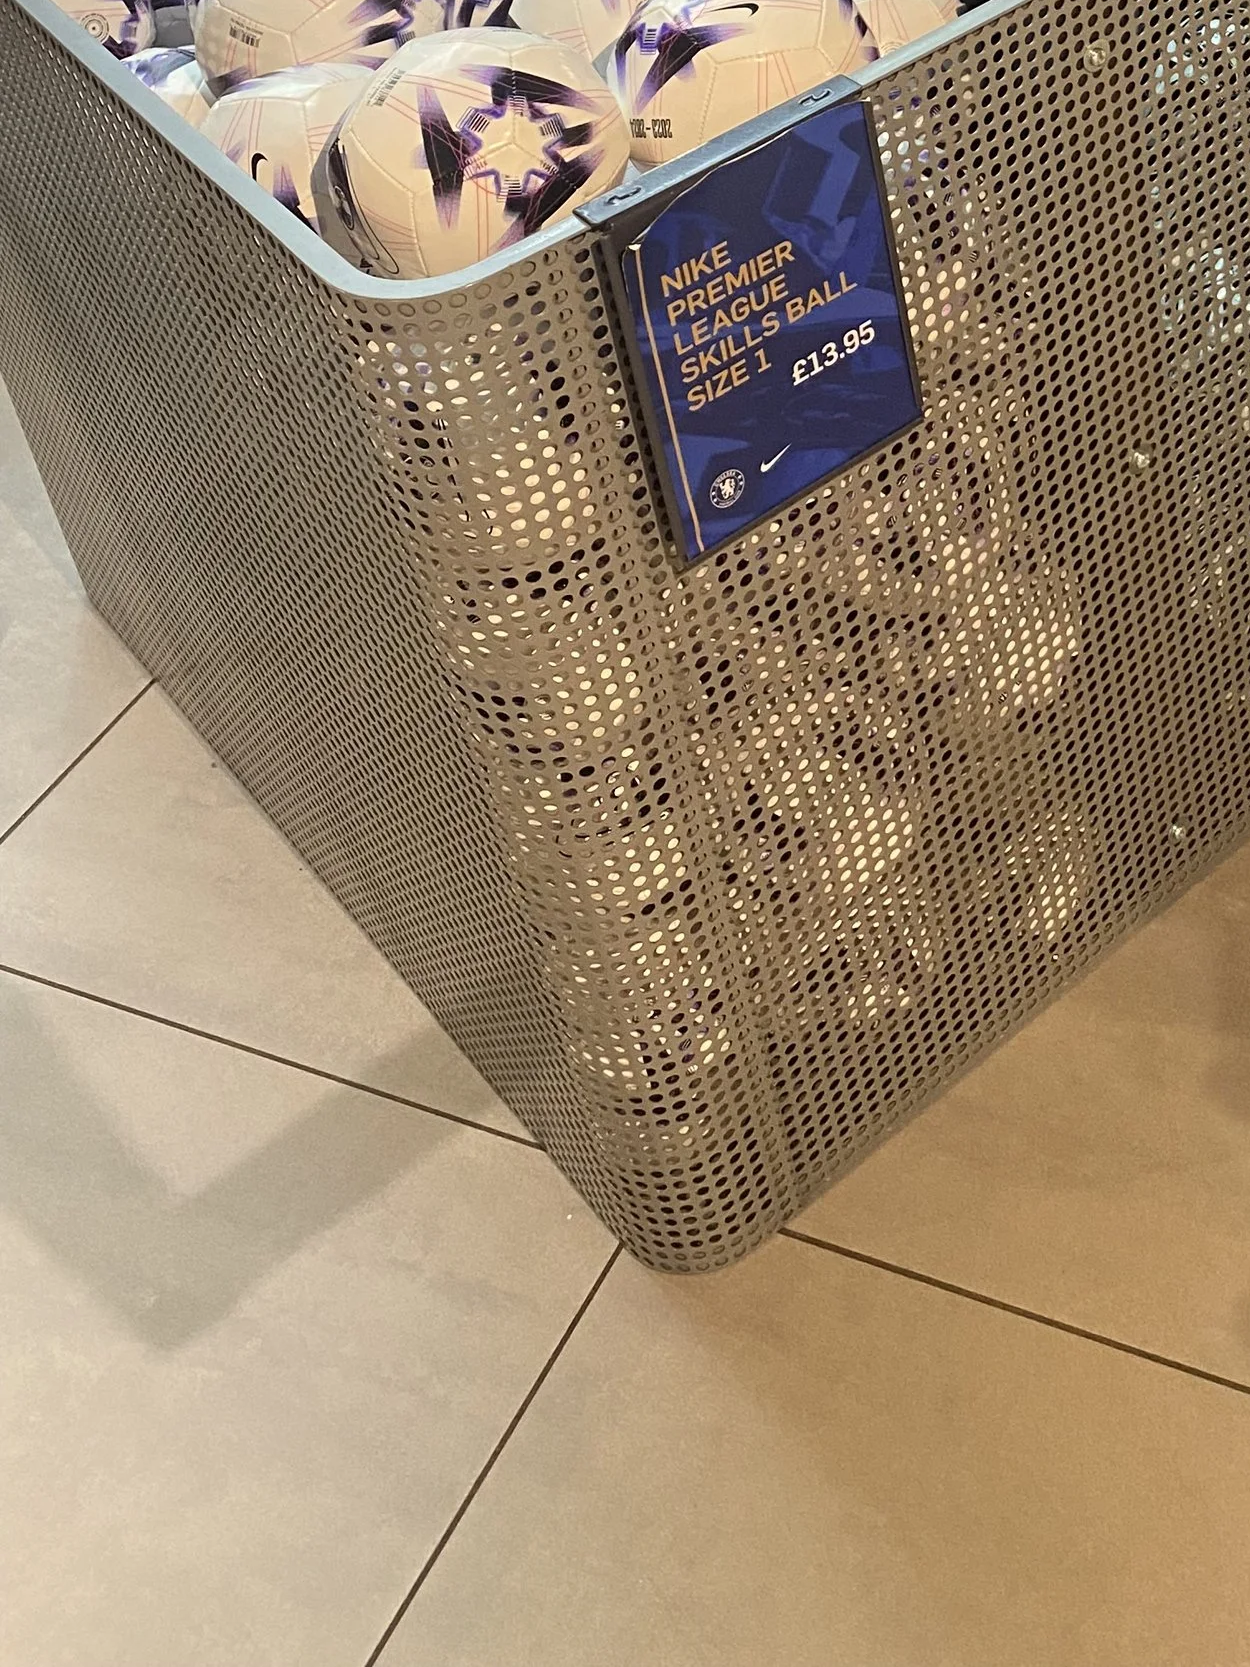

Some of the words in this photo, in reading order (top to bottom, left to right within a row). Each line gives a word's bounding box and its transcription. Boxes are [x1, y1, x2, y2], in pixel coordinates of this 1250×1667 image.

[660, 240, 732, 298] NIKE
[666, 240, 796, 327] PREMIER
[673, 274, 789, 355] LEAGUE
[681, 311, 781, 384] SKILLS
[786, 271, 858, 324] BALL
[687, 358, 750, 412] SIZE
[757, 349, 772, 374] 1
[791, 320, 875, 386] £13.95
